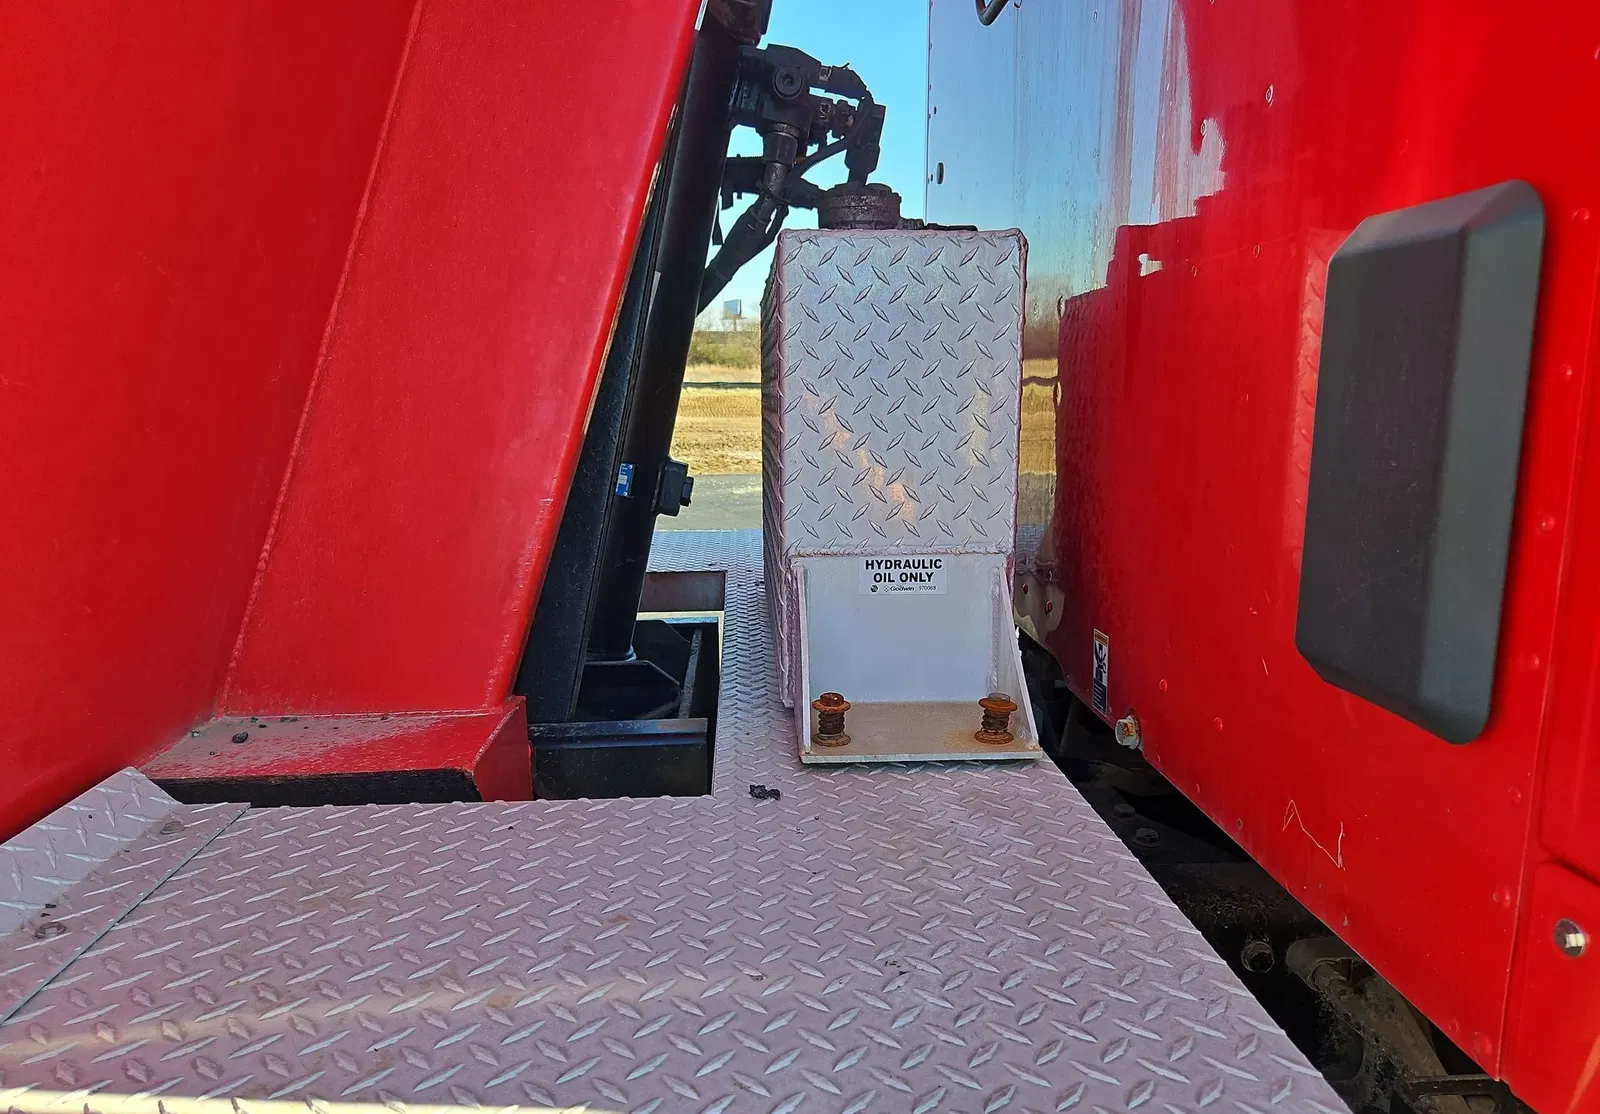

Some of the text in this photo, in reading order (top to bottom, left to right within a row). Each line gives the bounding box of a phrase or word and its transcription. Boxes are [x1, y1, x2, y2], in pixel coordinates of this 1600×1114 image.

[865, 559, 942, 570] HYDRAULIC
[873, 572, 934, 583] OIL ONLY
